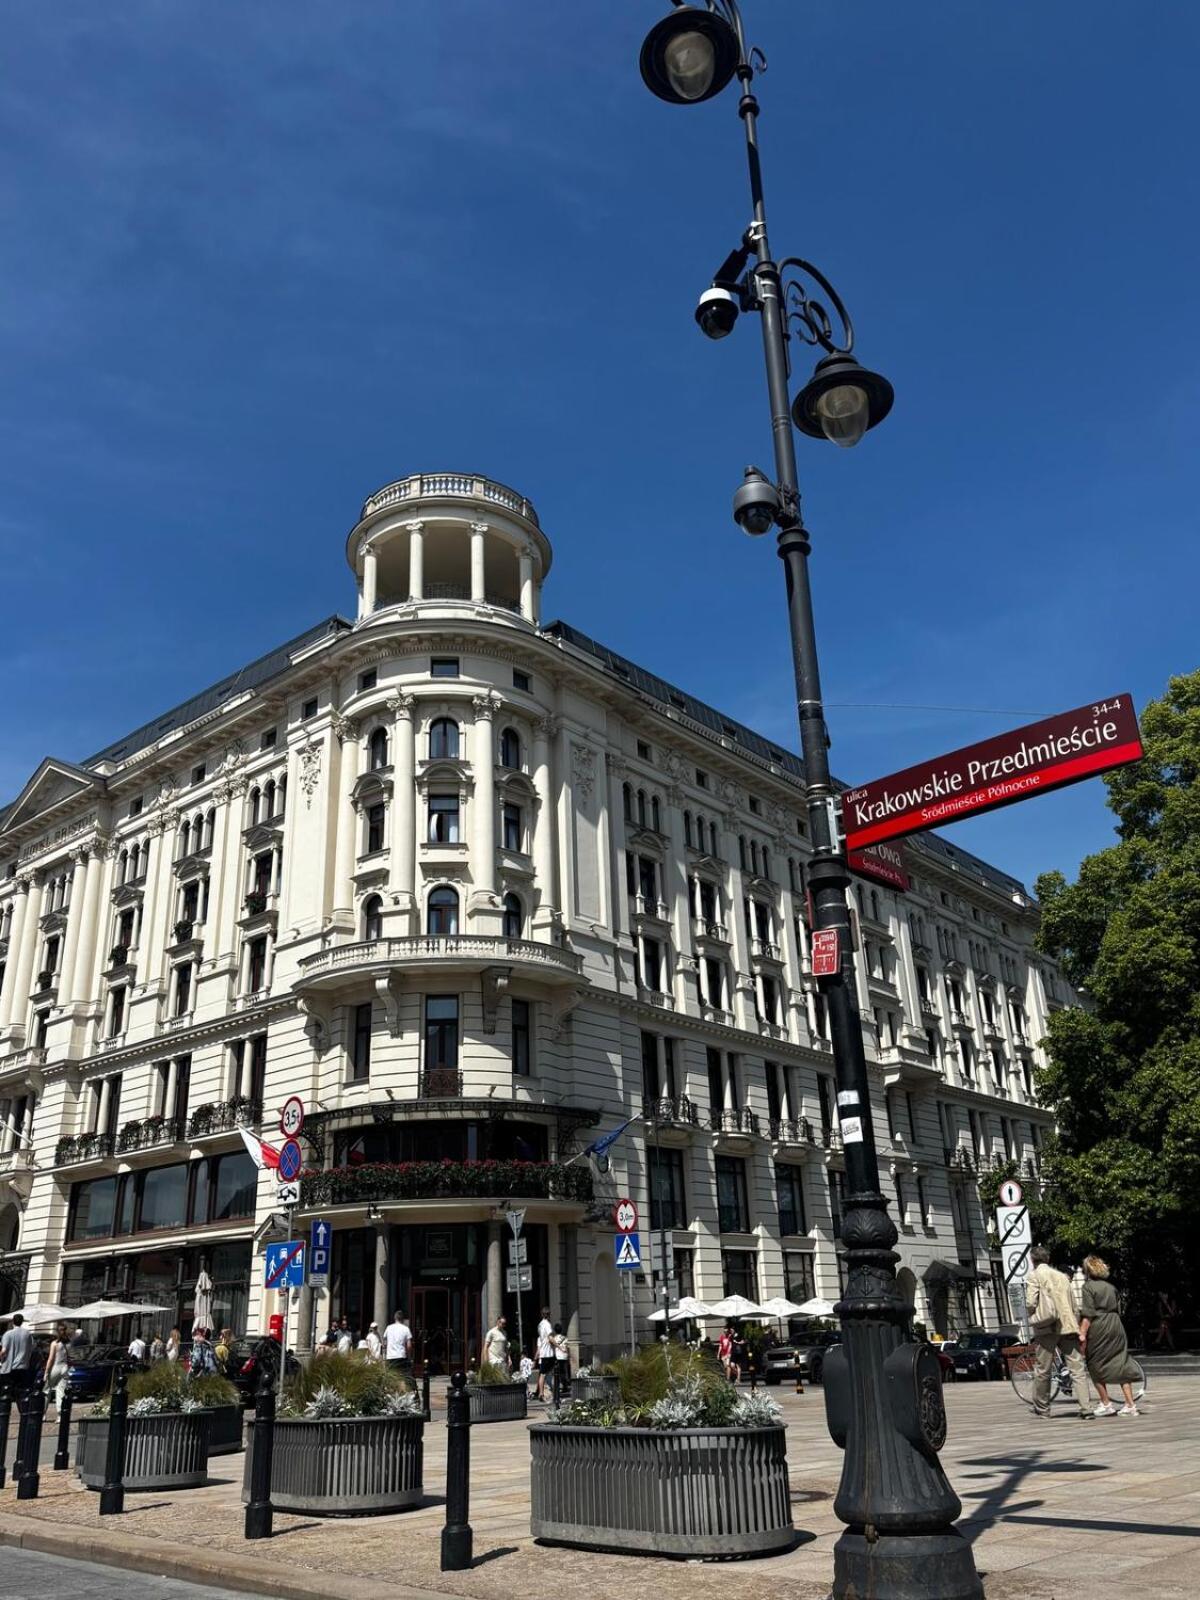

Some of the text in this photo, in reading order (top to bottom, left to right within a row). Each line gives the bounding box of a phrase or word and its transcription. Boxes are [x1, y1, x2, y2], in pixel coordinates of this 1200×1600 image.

[1092, 700, 1122, 718] 34-4
[855, 720, 1118, 826] Krakowskie Przedmieście
[846, 788, 868, 803] ulica
[921, 773, 1041, 821] Śródmieście Północne
[864, 844, 902, 868] rowa
[314, 1250, 326, 1270] P
